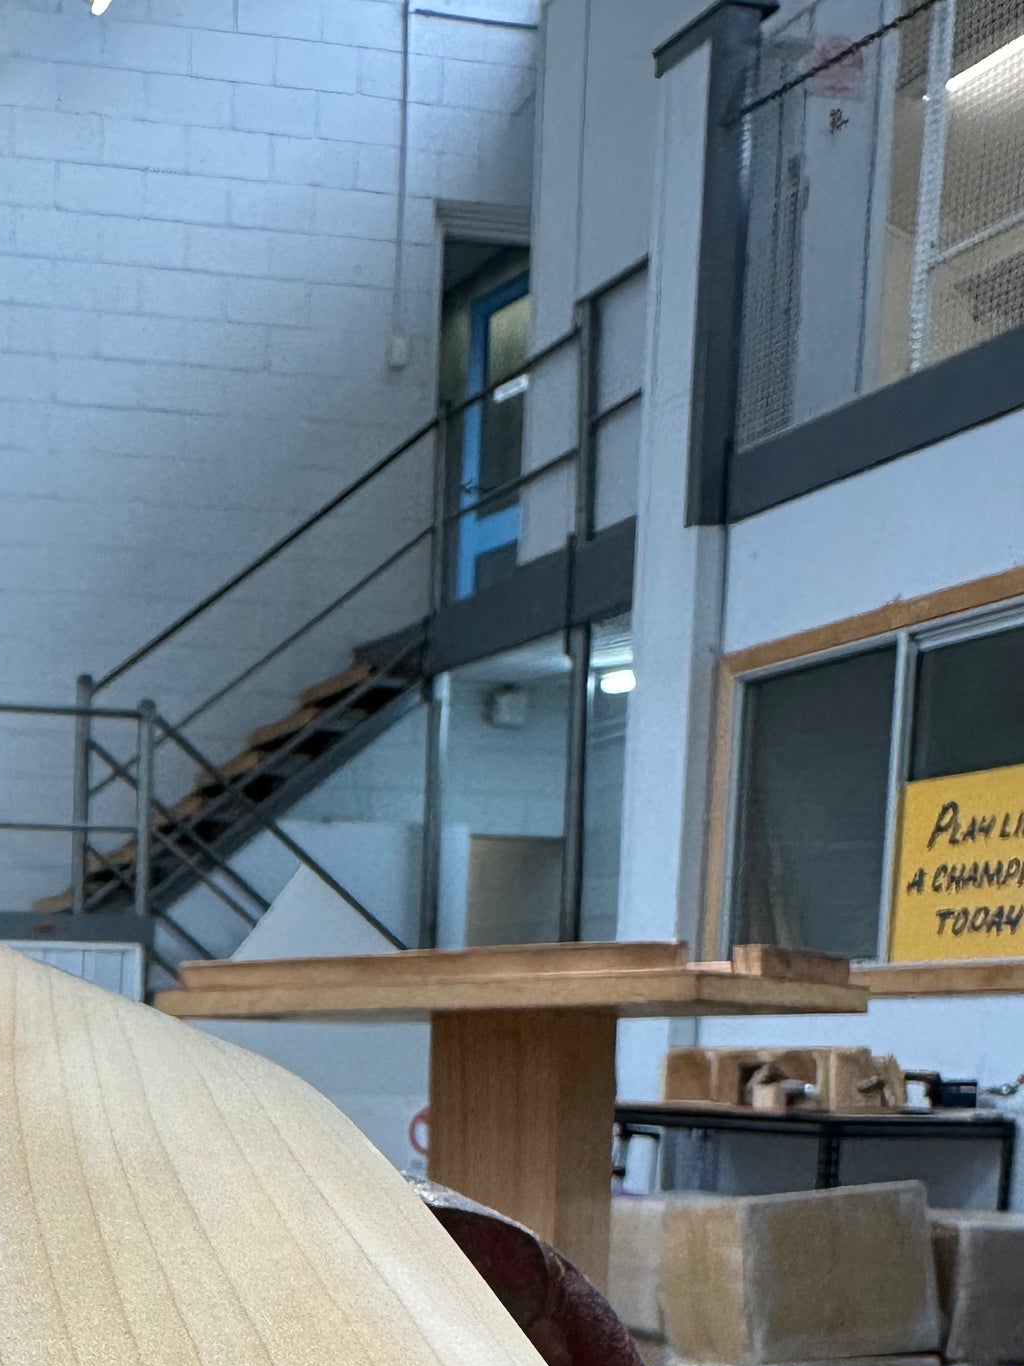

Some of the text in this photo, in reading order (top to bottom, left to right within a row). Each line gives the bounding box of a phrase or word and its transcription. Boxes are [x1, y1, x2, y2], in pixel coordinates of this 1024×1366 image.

[927, 801, 1024, 850] PLAY LI
[906, 867, 927, 895] A
[936, 905, 1024, 936] TODAY
